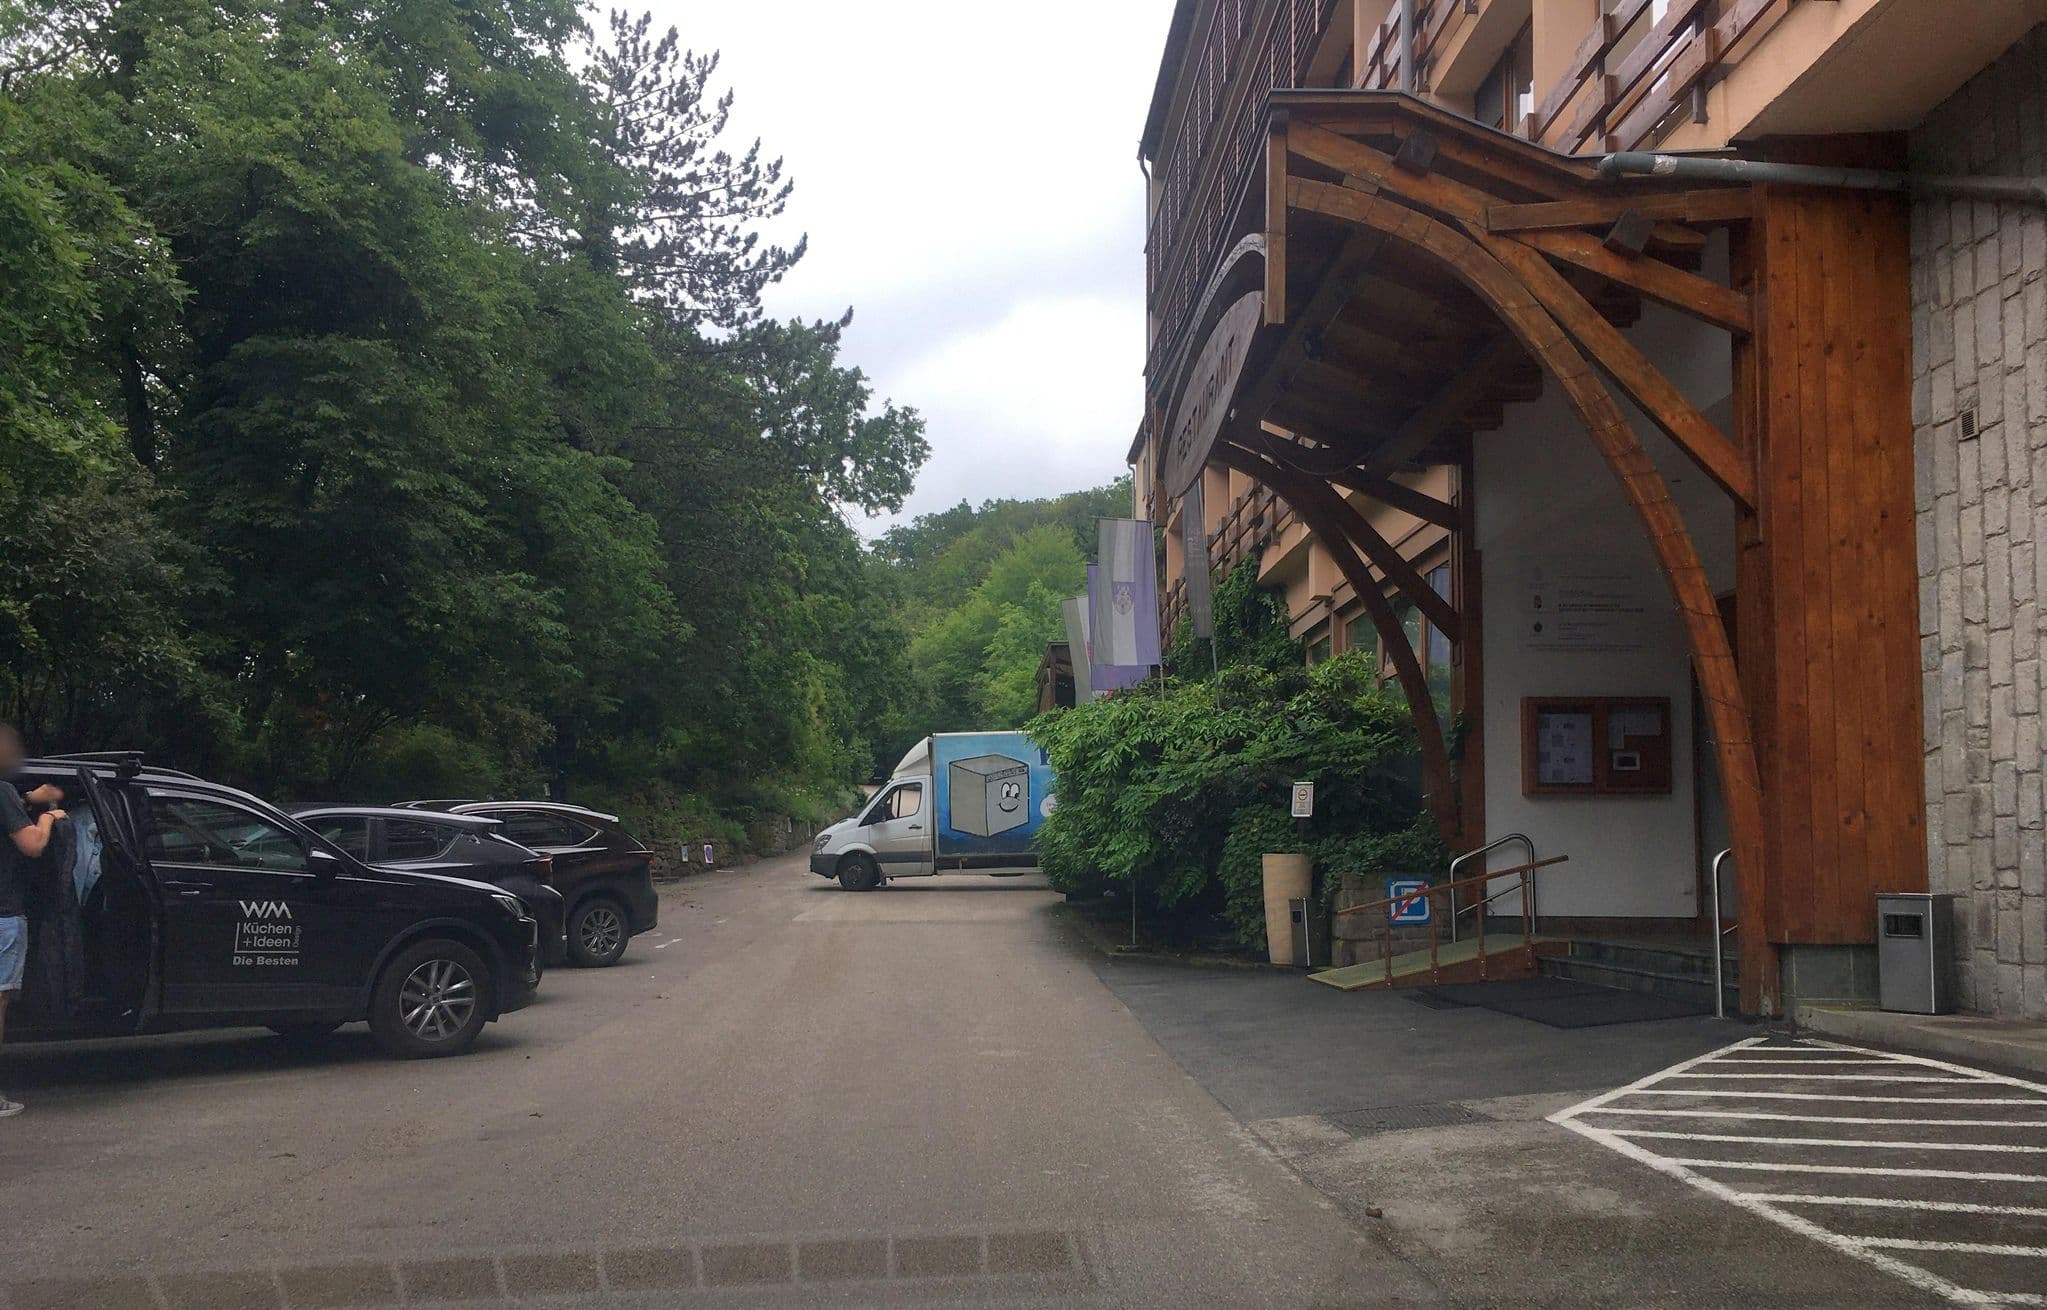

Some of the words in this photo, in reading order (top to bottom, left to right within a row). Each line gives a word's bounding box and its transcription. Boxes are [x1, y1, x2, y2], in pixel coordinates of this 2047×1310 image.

[1177, 335, 1235, 466] RESTAURANT
[239, 900, 292, 919] WM
[243, 922, 292, 934] Küchen
[232, 956, 253, 966] Die
[256, 956, 299, 966] Besten
